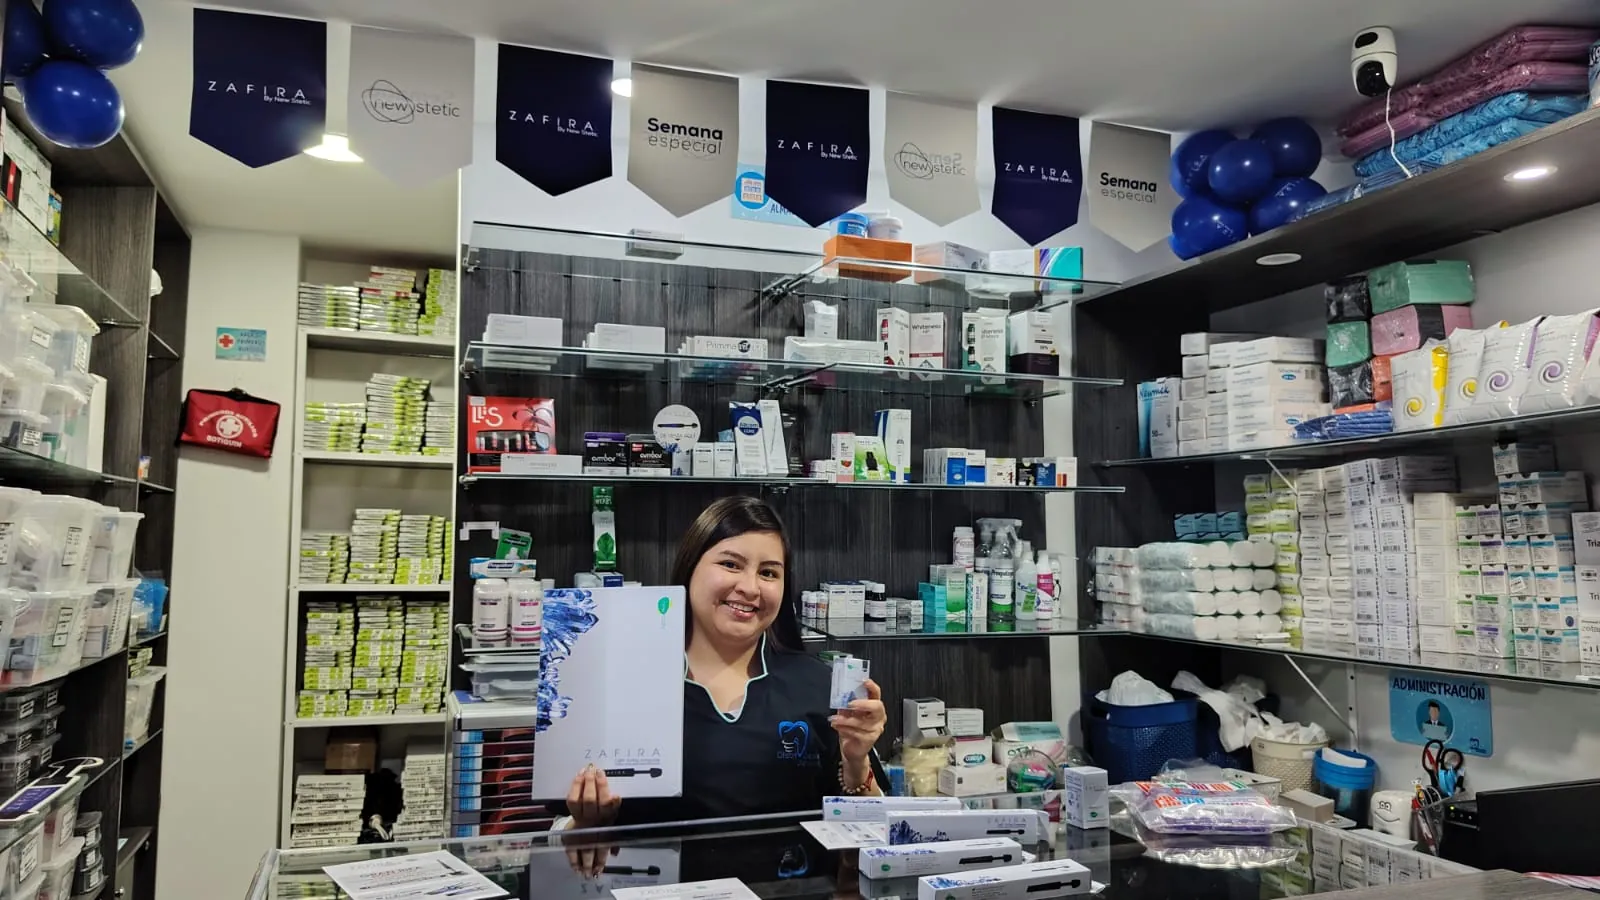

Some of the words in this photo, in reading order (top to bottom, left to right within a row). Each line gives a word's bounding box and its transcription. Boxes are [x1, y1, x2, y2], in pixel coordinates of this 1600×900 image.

[208, 80, 305, 99] ZAFIRA
[509, 110, 594, 131] ZAFIRA
[647, 117, 723, 140] Semana
[648, 135, 721, 155] especial
[777, 139, 853, 155] ZAFIRA
[1003, 162, 1059, 178] ZAFIRA
[1100, 172, 1157, 193] Semana
[1100, 187, 1156, 204] especial
[1392, 677, 1486, 701] ADMINISTRACIÓN
[584, 748, 661, 759] ZAFIRA
